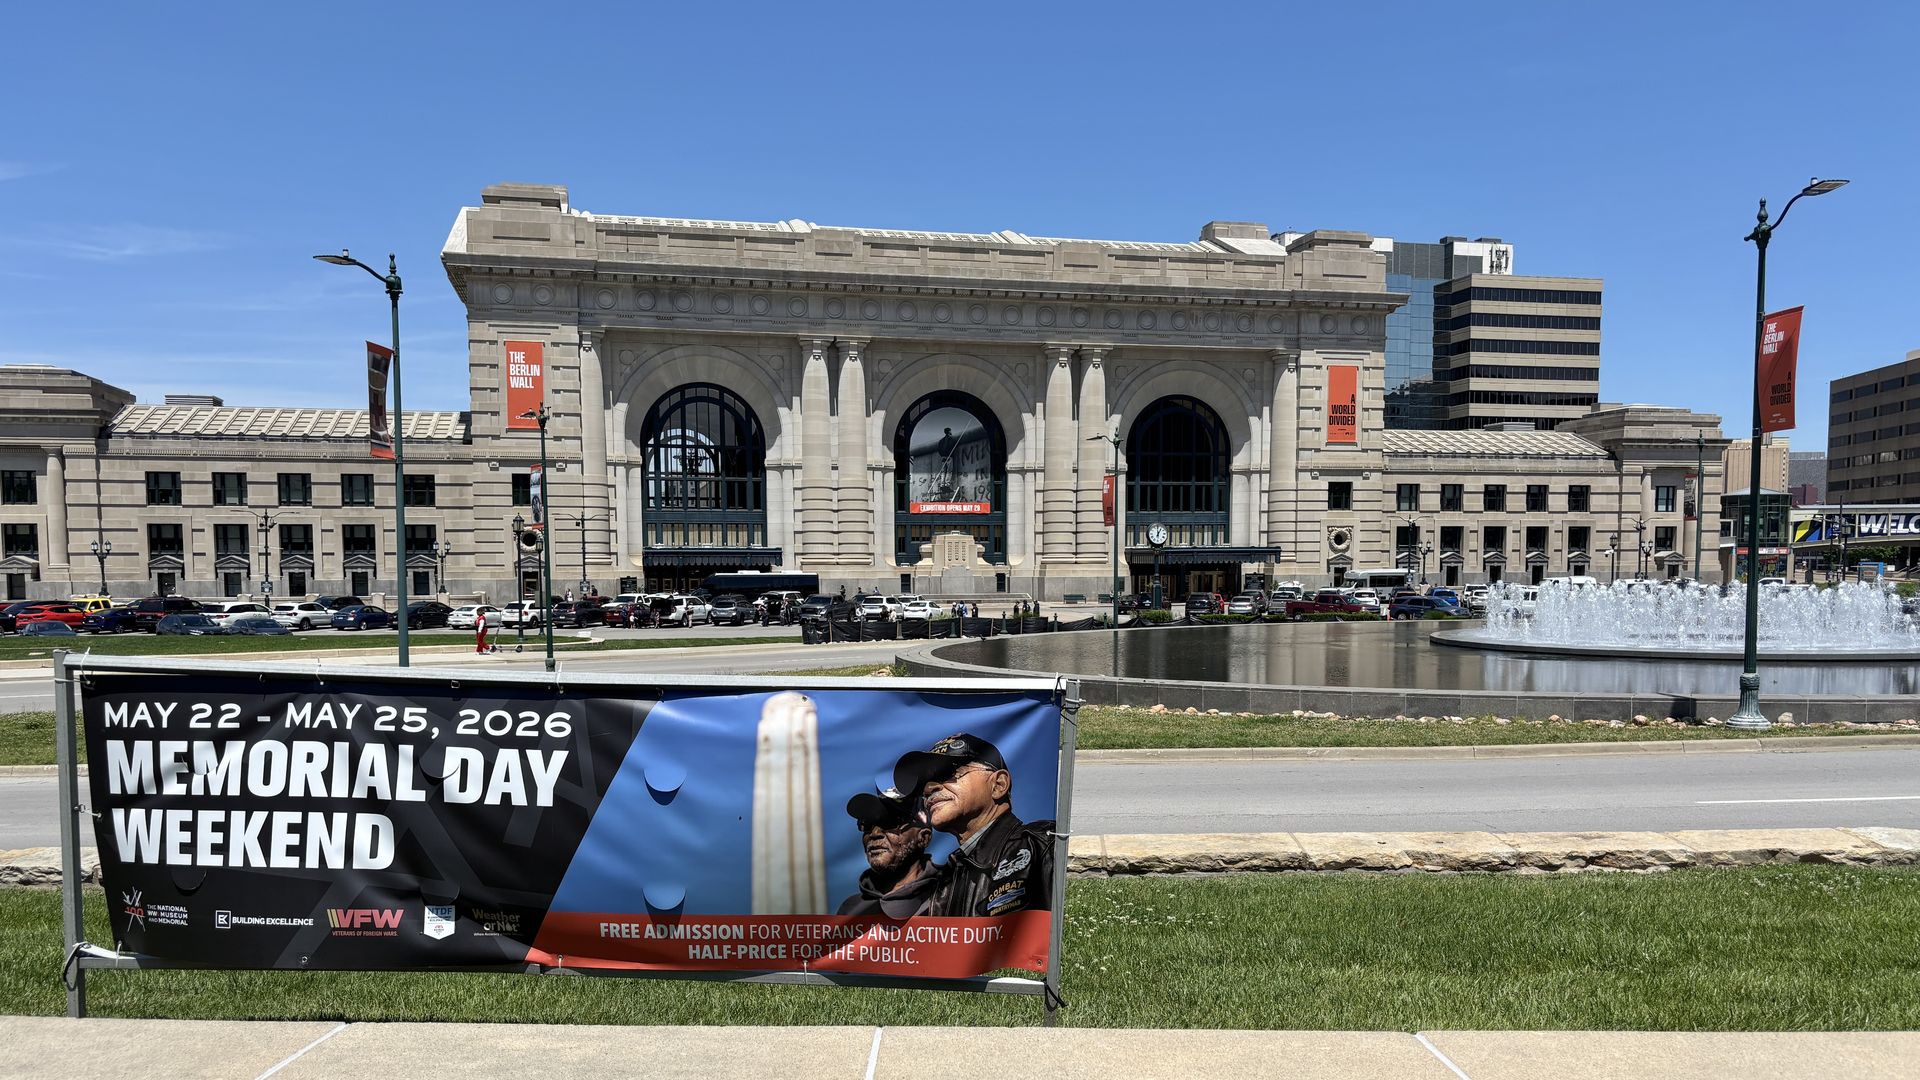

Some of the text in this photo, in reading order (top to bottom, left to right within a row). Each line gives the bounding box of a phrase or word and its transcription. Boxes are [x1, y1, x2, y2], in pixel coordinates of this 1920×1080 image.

[1766, 322, 1777, 333] THE
[1764, 331, 1785, 344] BERLIN
[1762, 342, 1778, 354] WALL
[509, 352, 525, 363] THE
[509, 364, 541, 376] BERLIN
[1787, 371, 1791, 381] A
[509, 376, 534, 389] WALL
[1770, 383, 1792, 395] WORLD
[1351, 394, 1355, 404] A
[1769, 393, 1792, 406] DIVIDED
[1331, 405, 1355, 415] WORLD
[1329, 416, 1355, 425] DIVIDED
[946, 504, 962, 512] OPENS
[962, 504, 973, 512] MAY
[104, 702, 178, 729] MAY
[189, 703, 242, 729] 22
[284, 702, 363, 730] MAY
[374, 705, 440, 740] 25,
[456, 709, 572, 738] 2026
[106, 739, 570, 807] MEMORIAL DAY
[111, 808, 395, 870] WEEKEND
[988, 880, 1024, 902] COMBAT
[157, 904, 188, 913] NATIONAL
[160, 911, 188, 919] MUSEUM
[232, 916, 314, 926] BUILDING EXCELLENCE
[336, 908, 405, 929] VFW
[472, 908, 521, 923] Weather
[158, 918, 189, 926] MEMORIAL
[600, 922, 1004, 944] FREE ADMISSION FOR VETERANS AND ACTIVE DUTY.
[688, 943, 920, 965] HALF-PRICE FOR THE PUBLIC.
